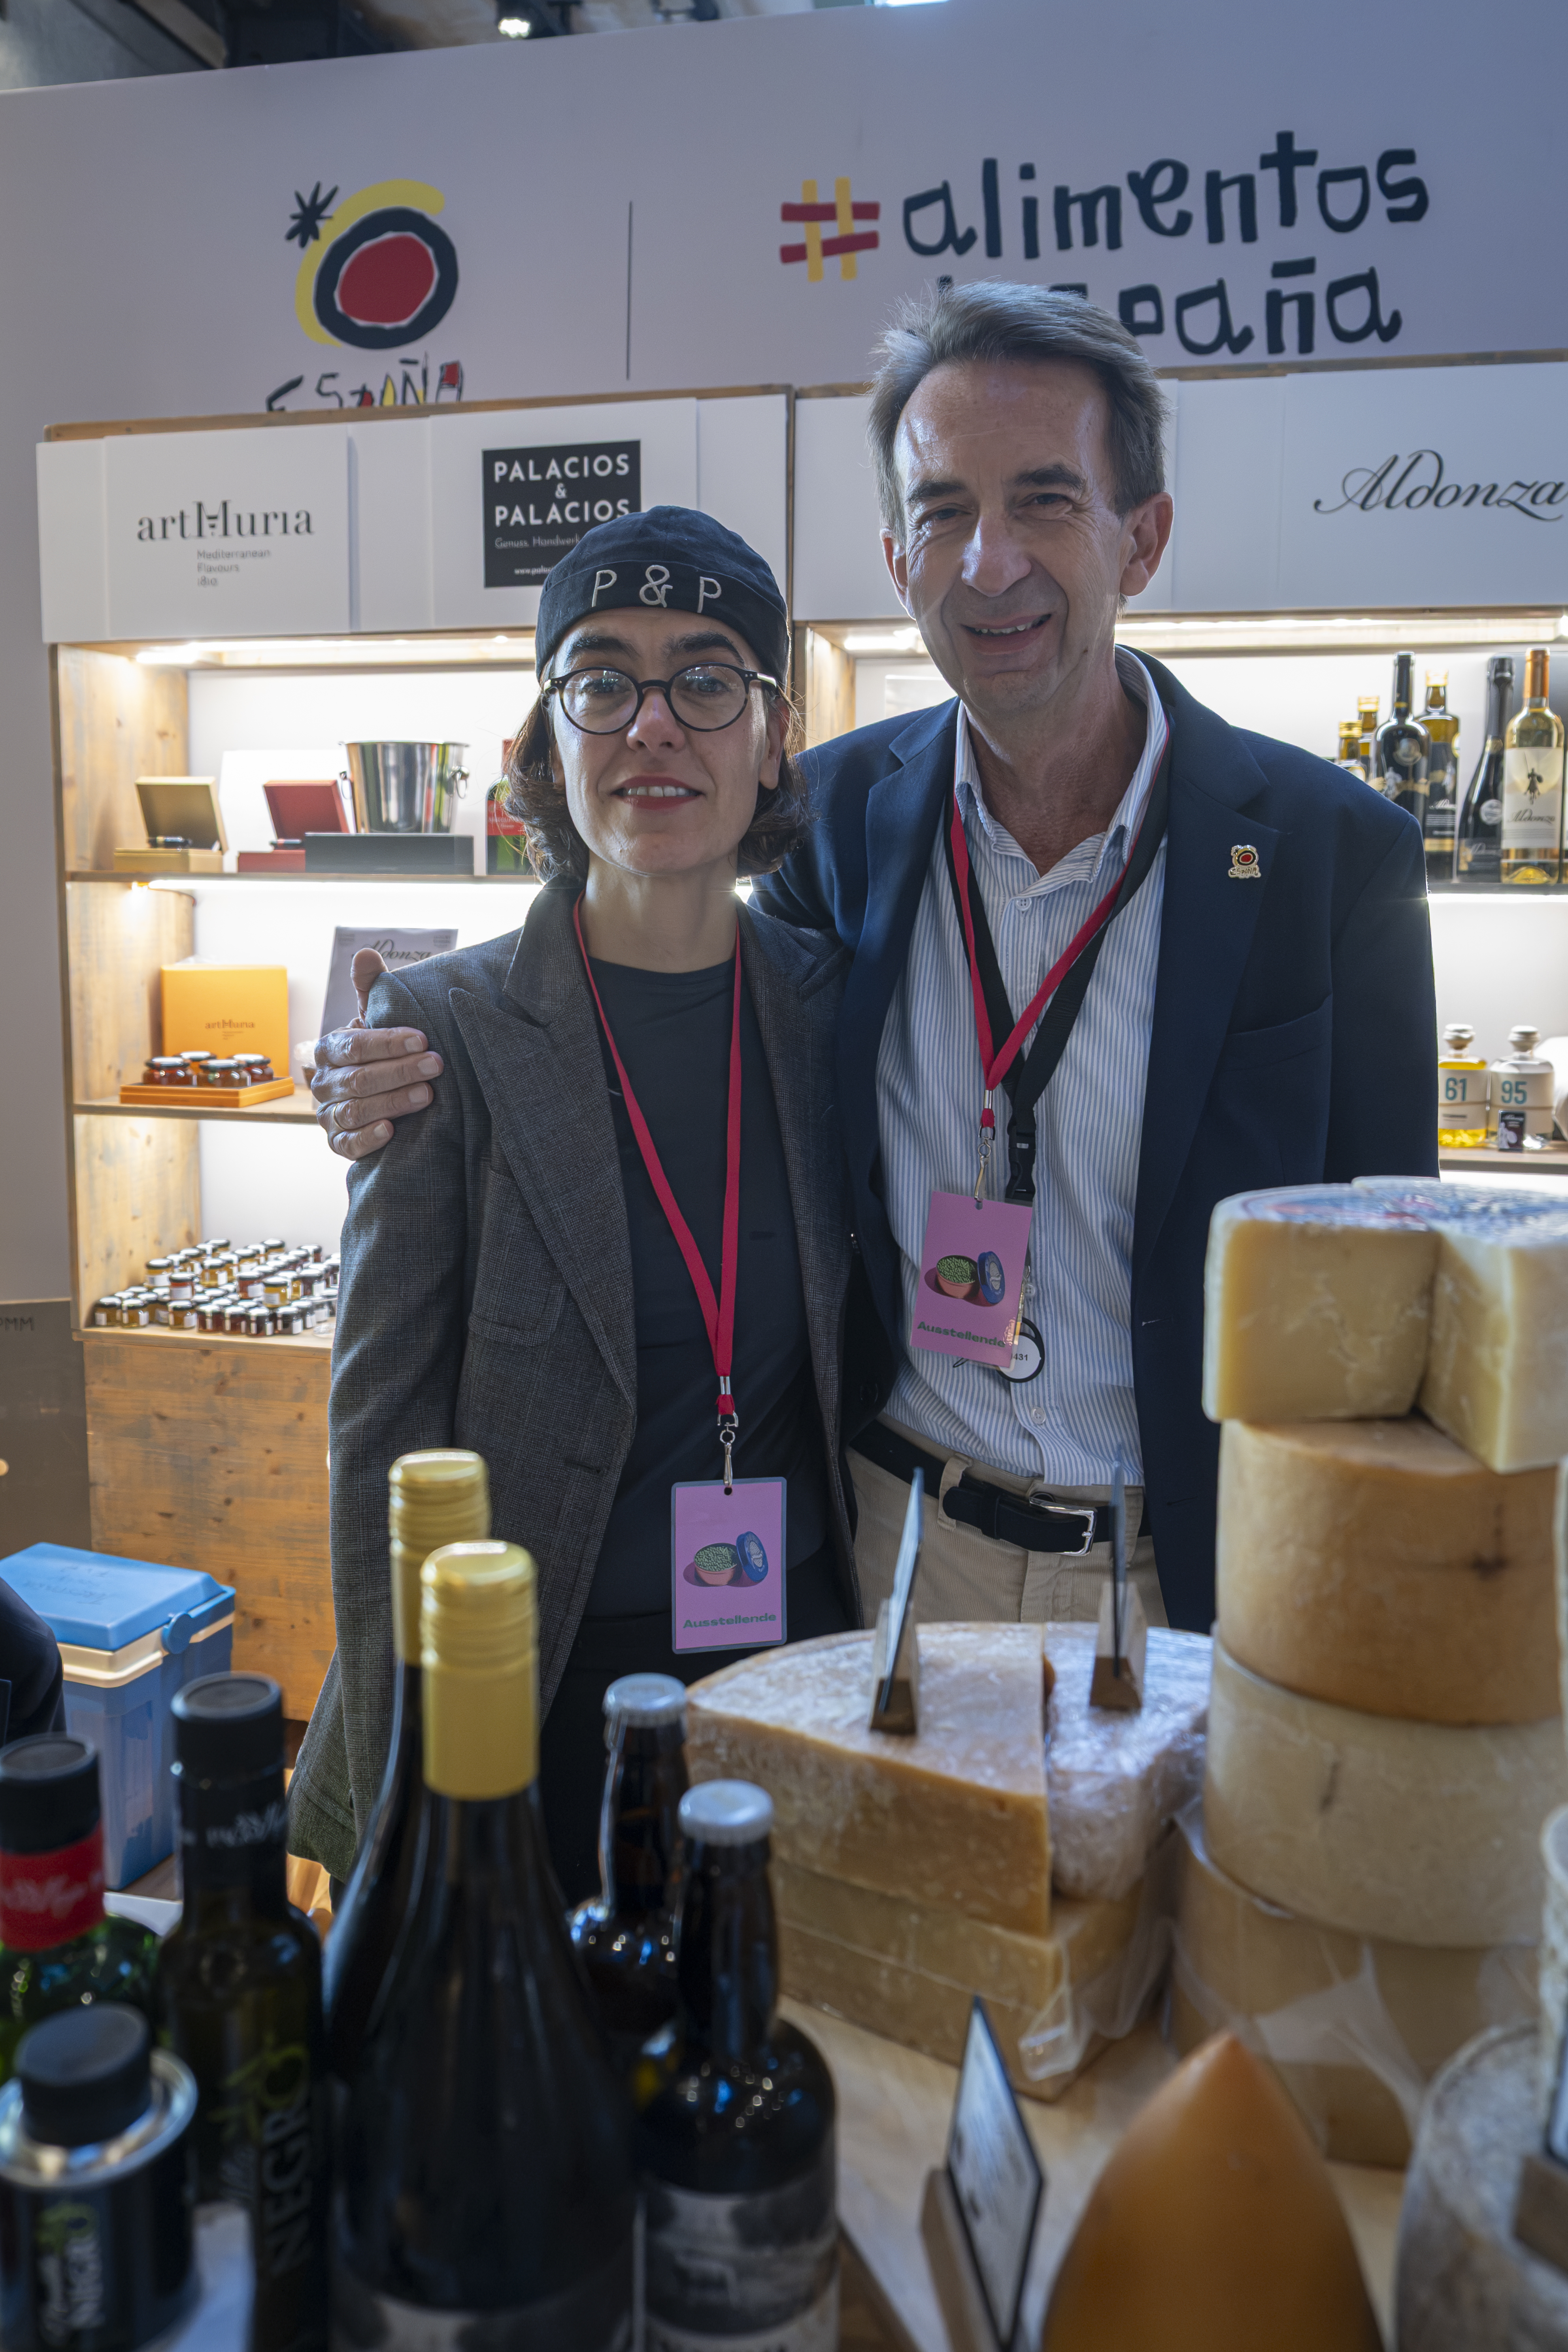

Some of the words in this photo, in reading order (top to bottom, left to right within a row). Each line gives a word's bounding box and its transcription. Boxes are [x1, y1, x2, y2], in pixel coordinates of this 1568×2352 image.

[494, 453, 630, 483] PALACIOS
[555, 482, 567, 499] &
[1313, 449, 1568, 523] Aldonza
[137, 500, 315, 542] artMuria
[495, 498, 630, 527] PALACIOS
[197, 549, 271, 559] Mediterranean
[197, 562, 240, 572] Flavours
[592, 570, 617, 607] P
[639, 564, 673, 608] &
[697, 576, 726, 613] P
[1445, 1077, 1468, 1102] 61
[1501, 1080, 1527, 1104] 95
[917, 1321, 1006, 1348] Ausstellende
[683, 1612, 777, 1629] Ausstellende
